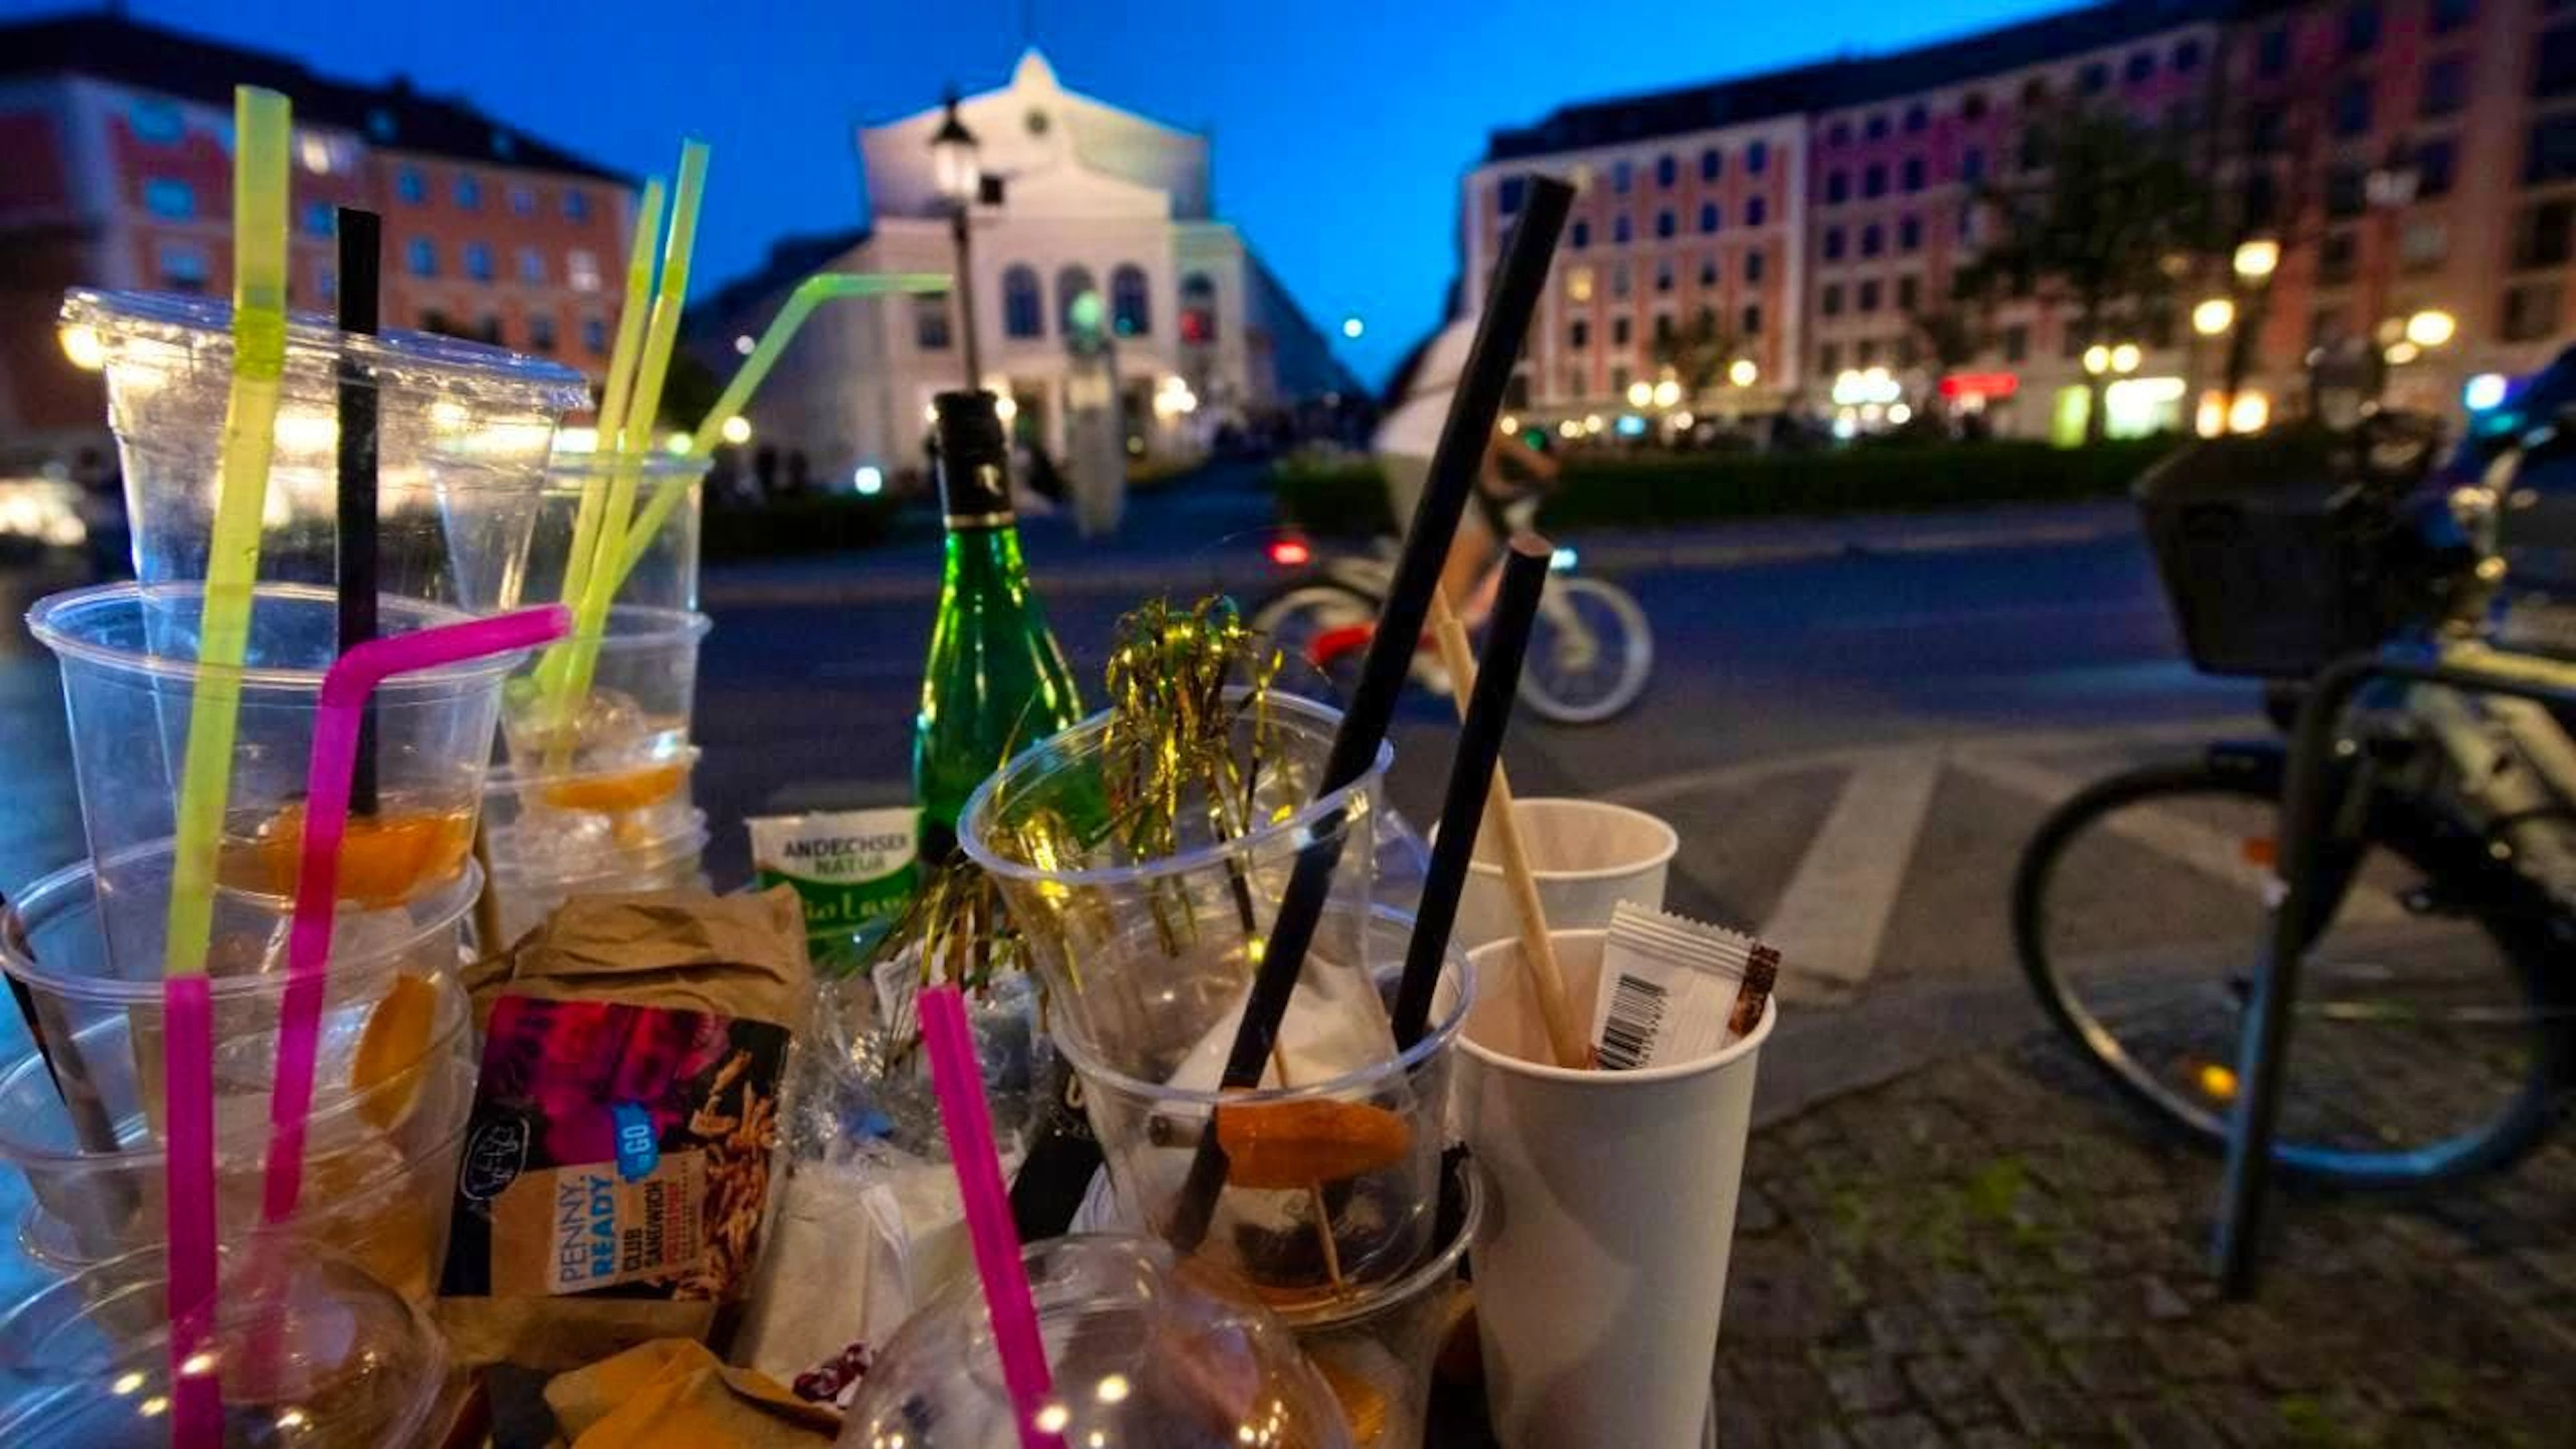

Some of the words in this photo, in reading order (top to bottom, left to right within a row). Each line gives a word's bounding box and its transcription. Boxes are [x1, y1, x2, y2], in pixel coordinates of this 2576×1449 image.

[814, 854, 885, 873] NATUR
[622, 1124, 651, 1155] GO
[589, 1175, 614, 1277] READY
[644, 1180, 663, 1267] SANDWICH
[624, 1227, 643, 1272] CLUB
